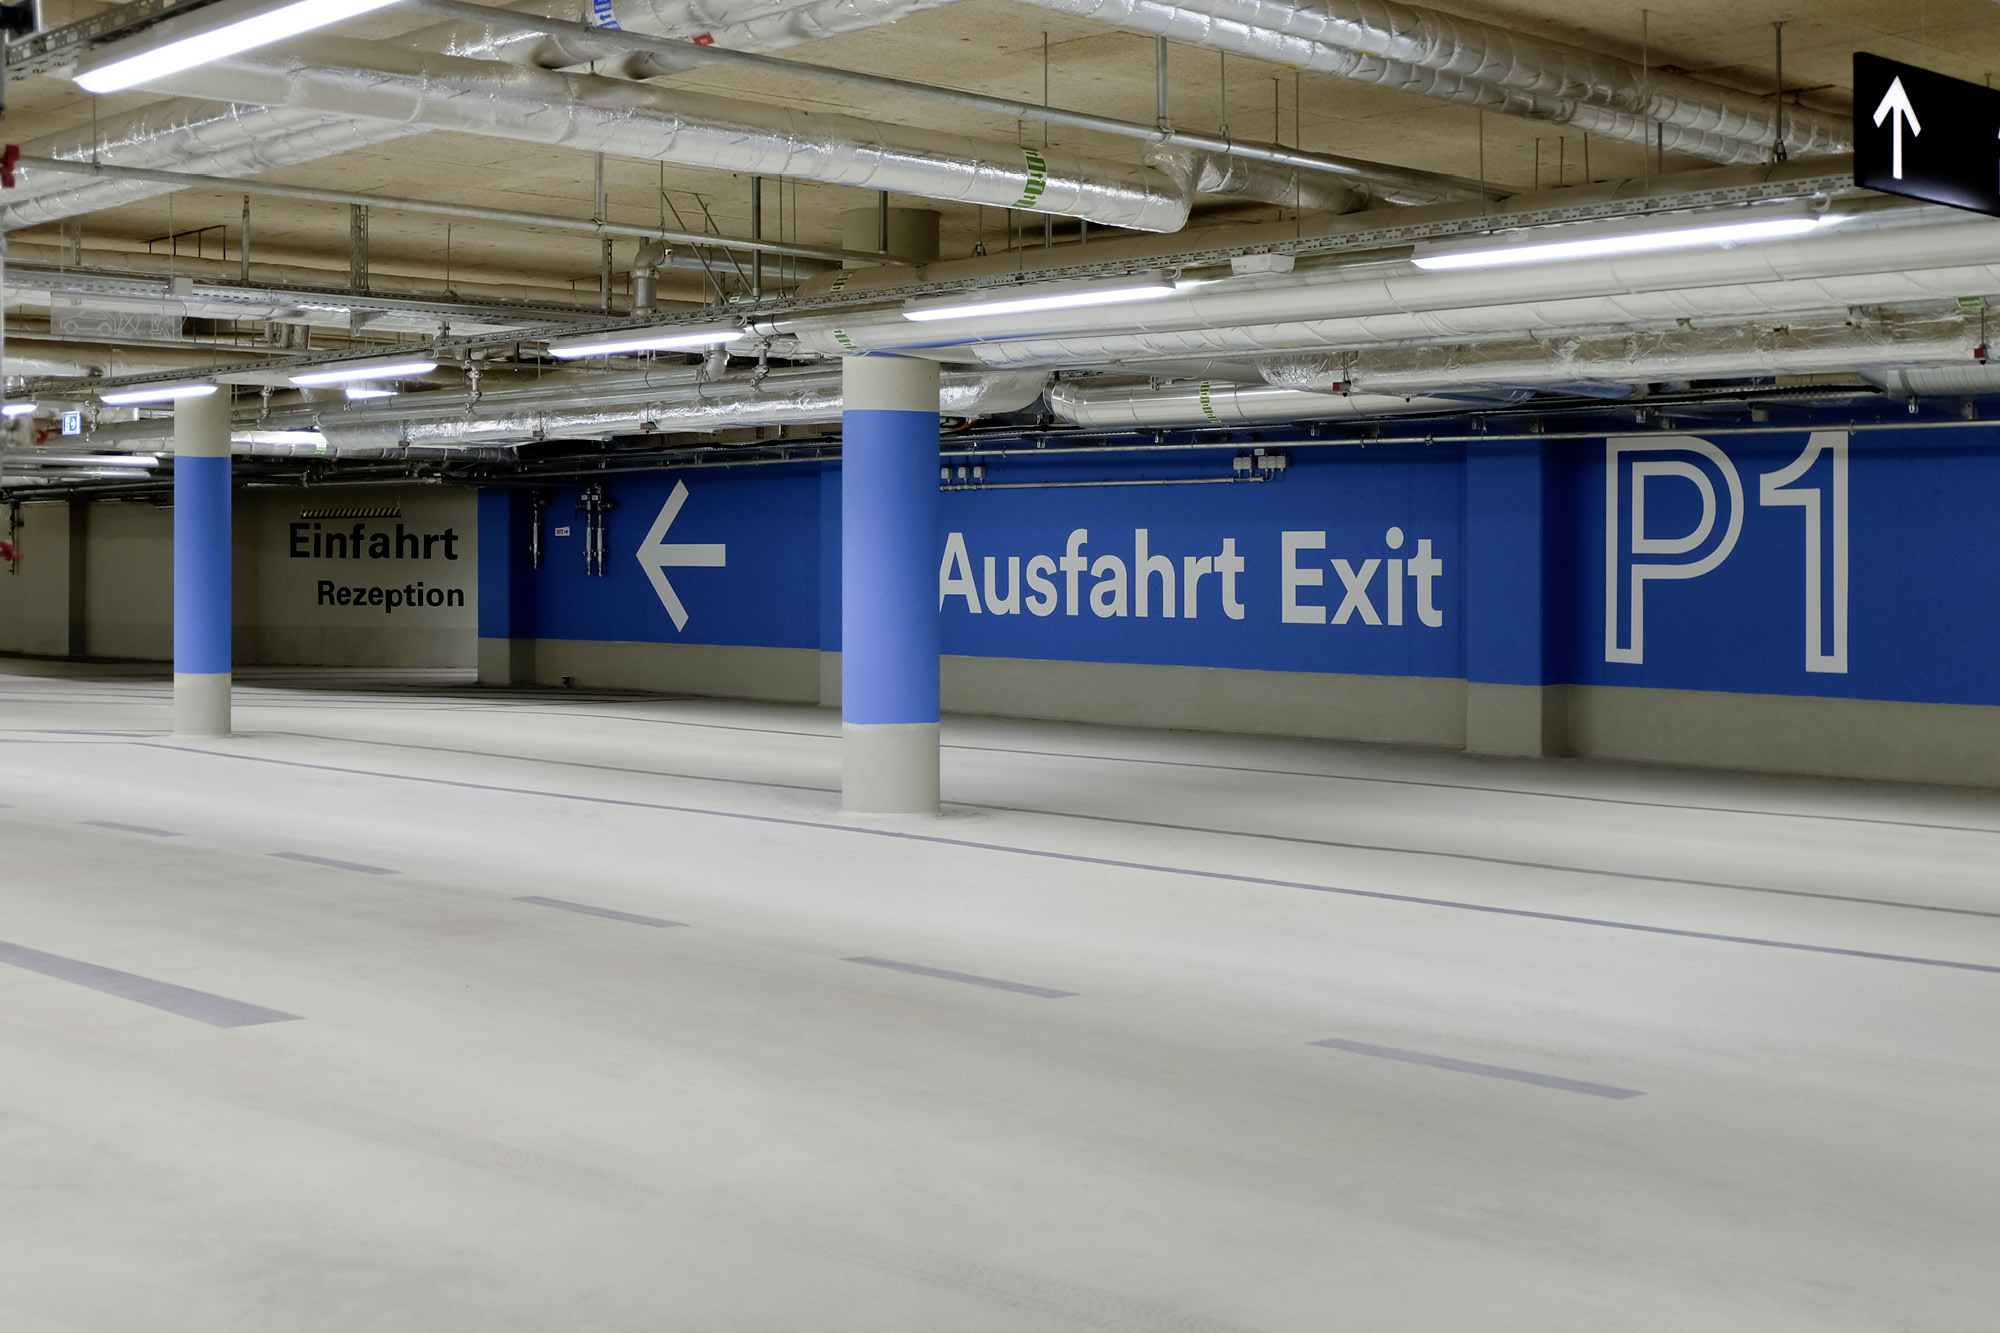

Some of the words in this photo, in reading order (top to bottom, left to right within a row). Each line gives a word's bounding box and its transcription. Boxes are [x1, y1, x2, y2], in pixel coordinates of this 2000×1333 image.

[290, 523, 459, 560] Einfahrt
[1605, 431, 1848, 674] P1
[318, 580, 465, 613] Rezeption
[939, 528, 1245, 620] Ausfahrt
[1281, 526, 1443, 628] Exit
